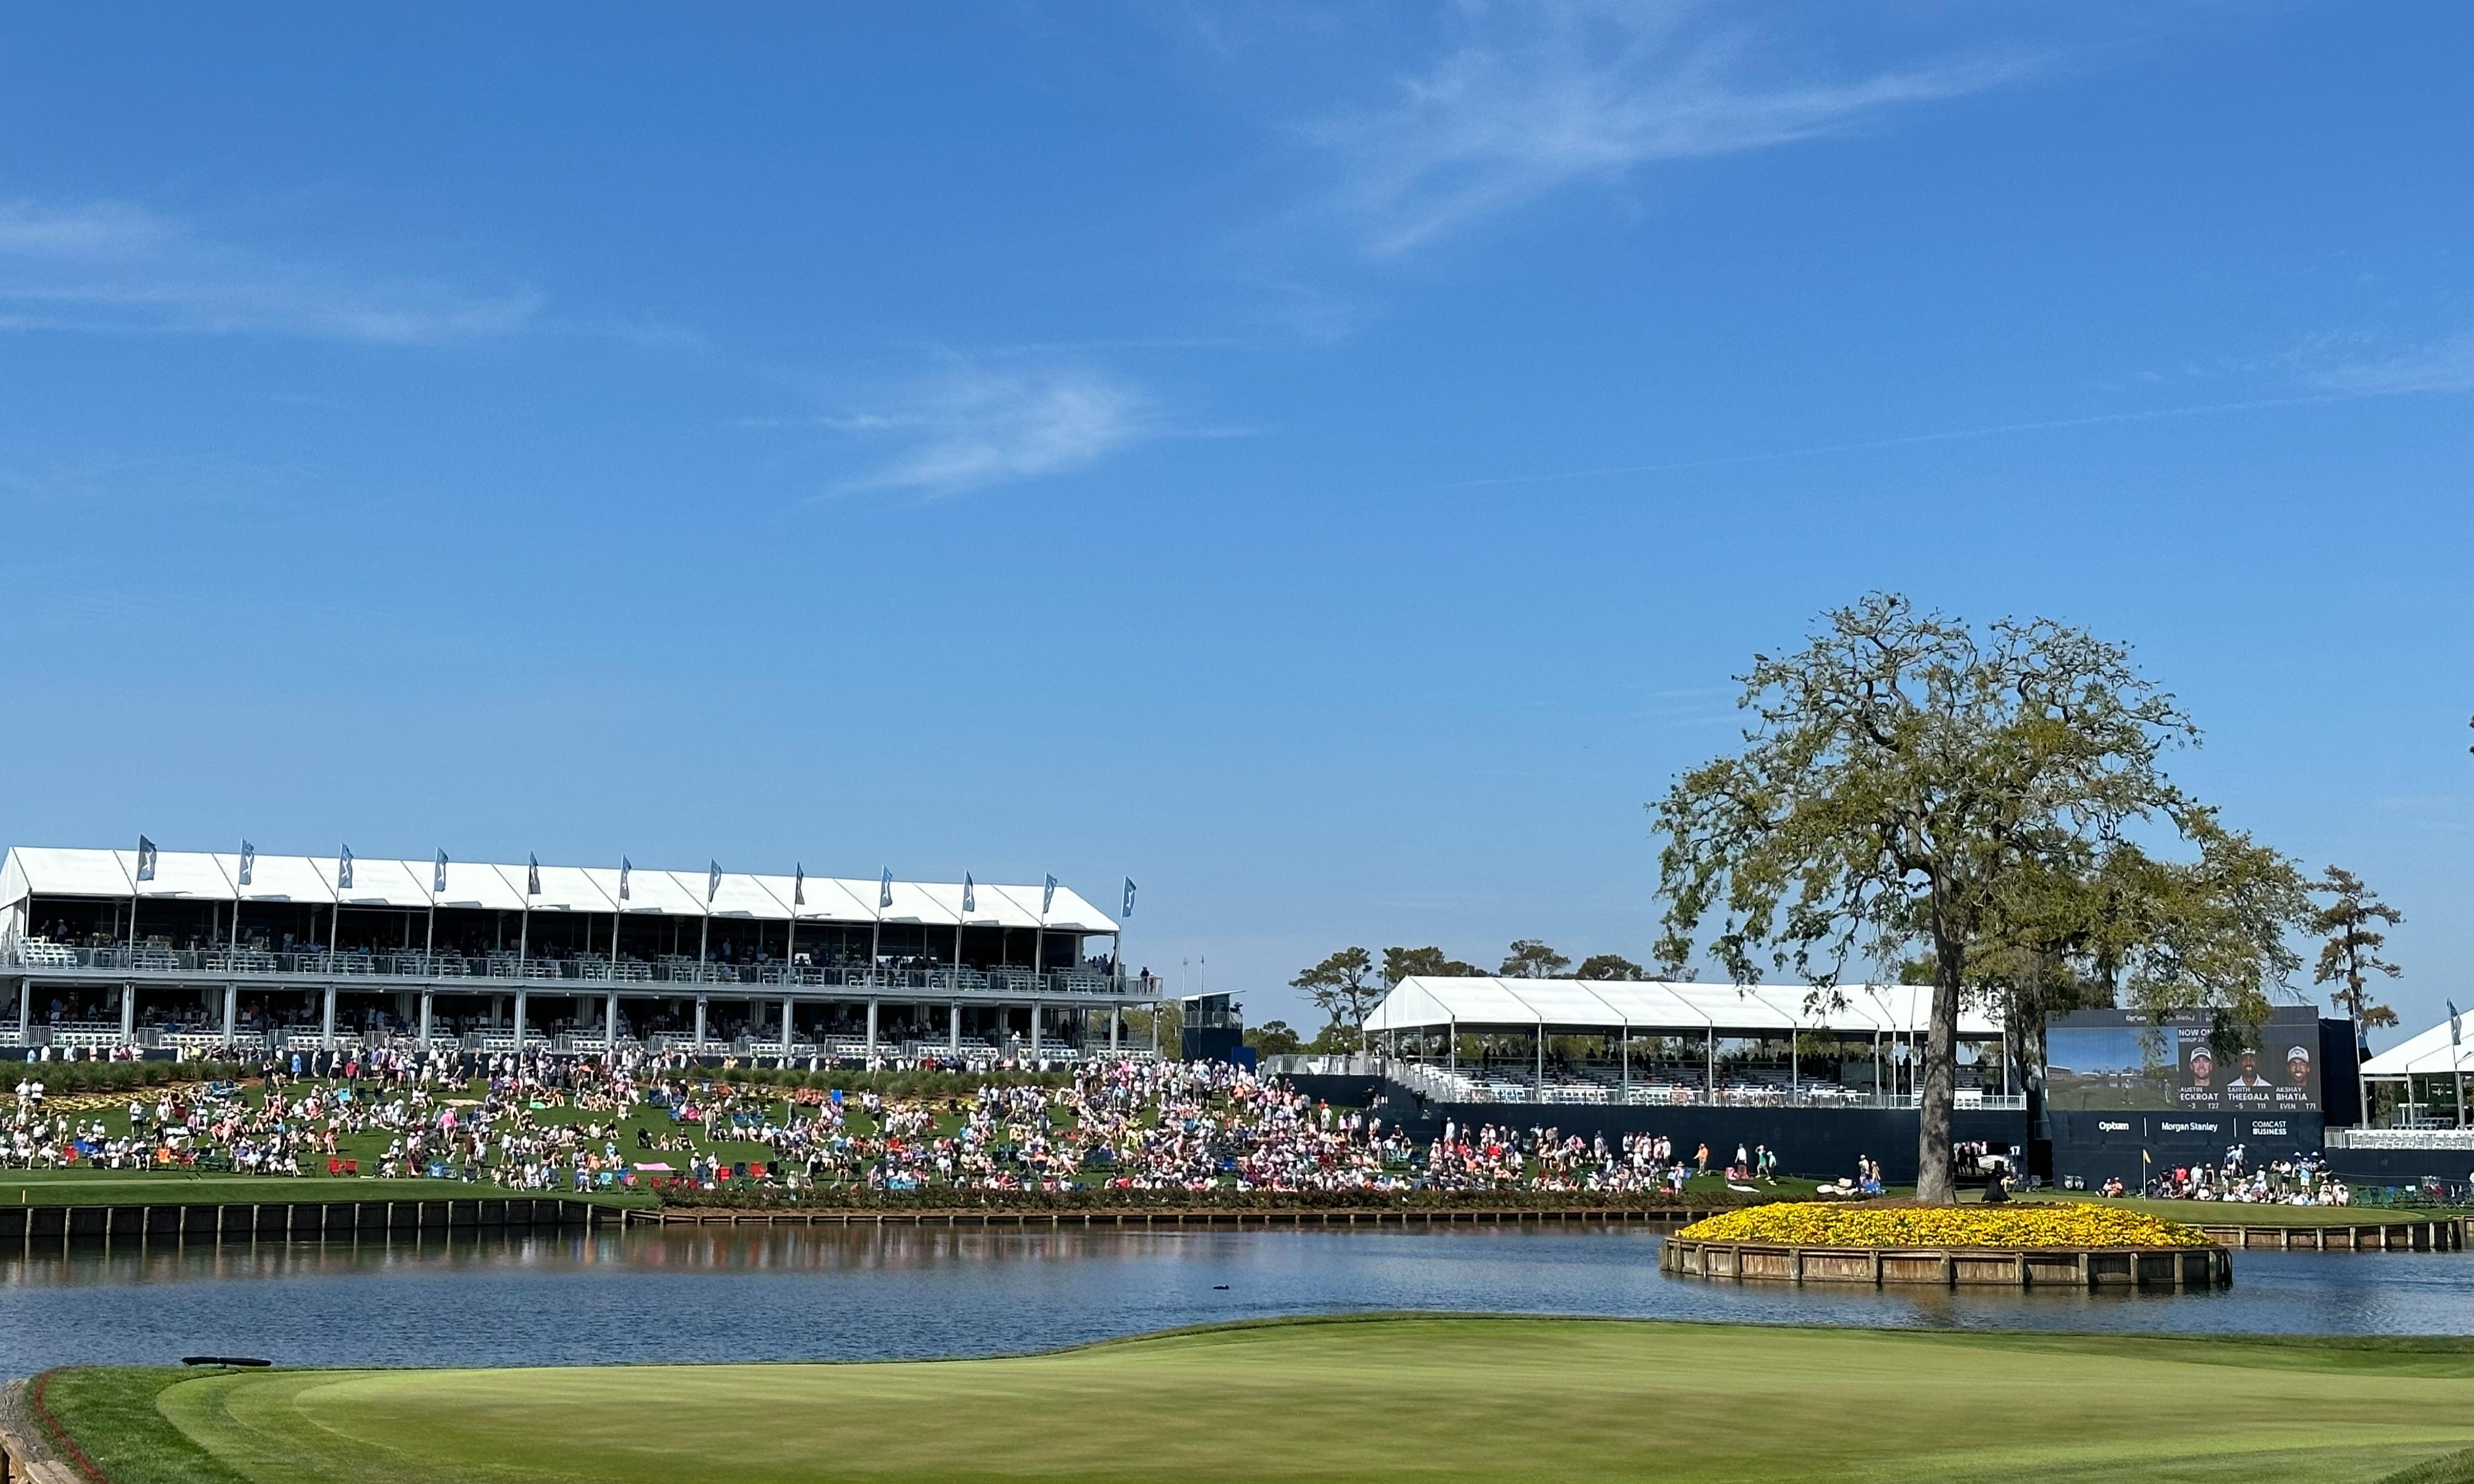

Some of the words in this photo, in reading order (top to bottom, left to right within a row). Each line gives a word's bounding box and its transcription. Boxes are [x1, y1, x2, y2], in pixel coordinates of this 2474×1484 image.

[2098, 1121, 2129, 1132] Optum
[2161, 1121, 2189, 1132] Morgan
[2190, 1121, 2218, 1132] Stanley
[2010, 1145, 2021, 1155] 17
